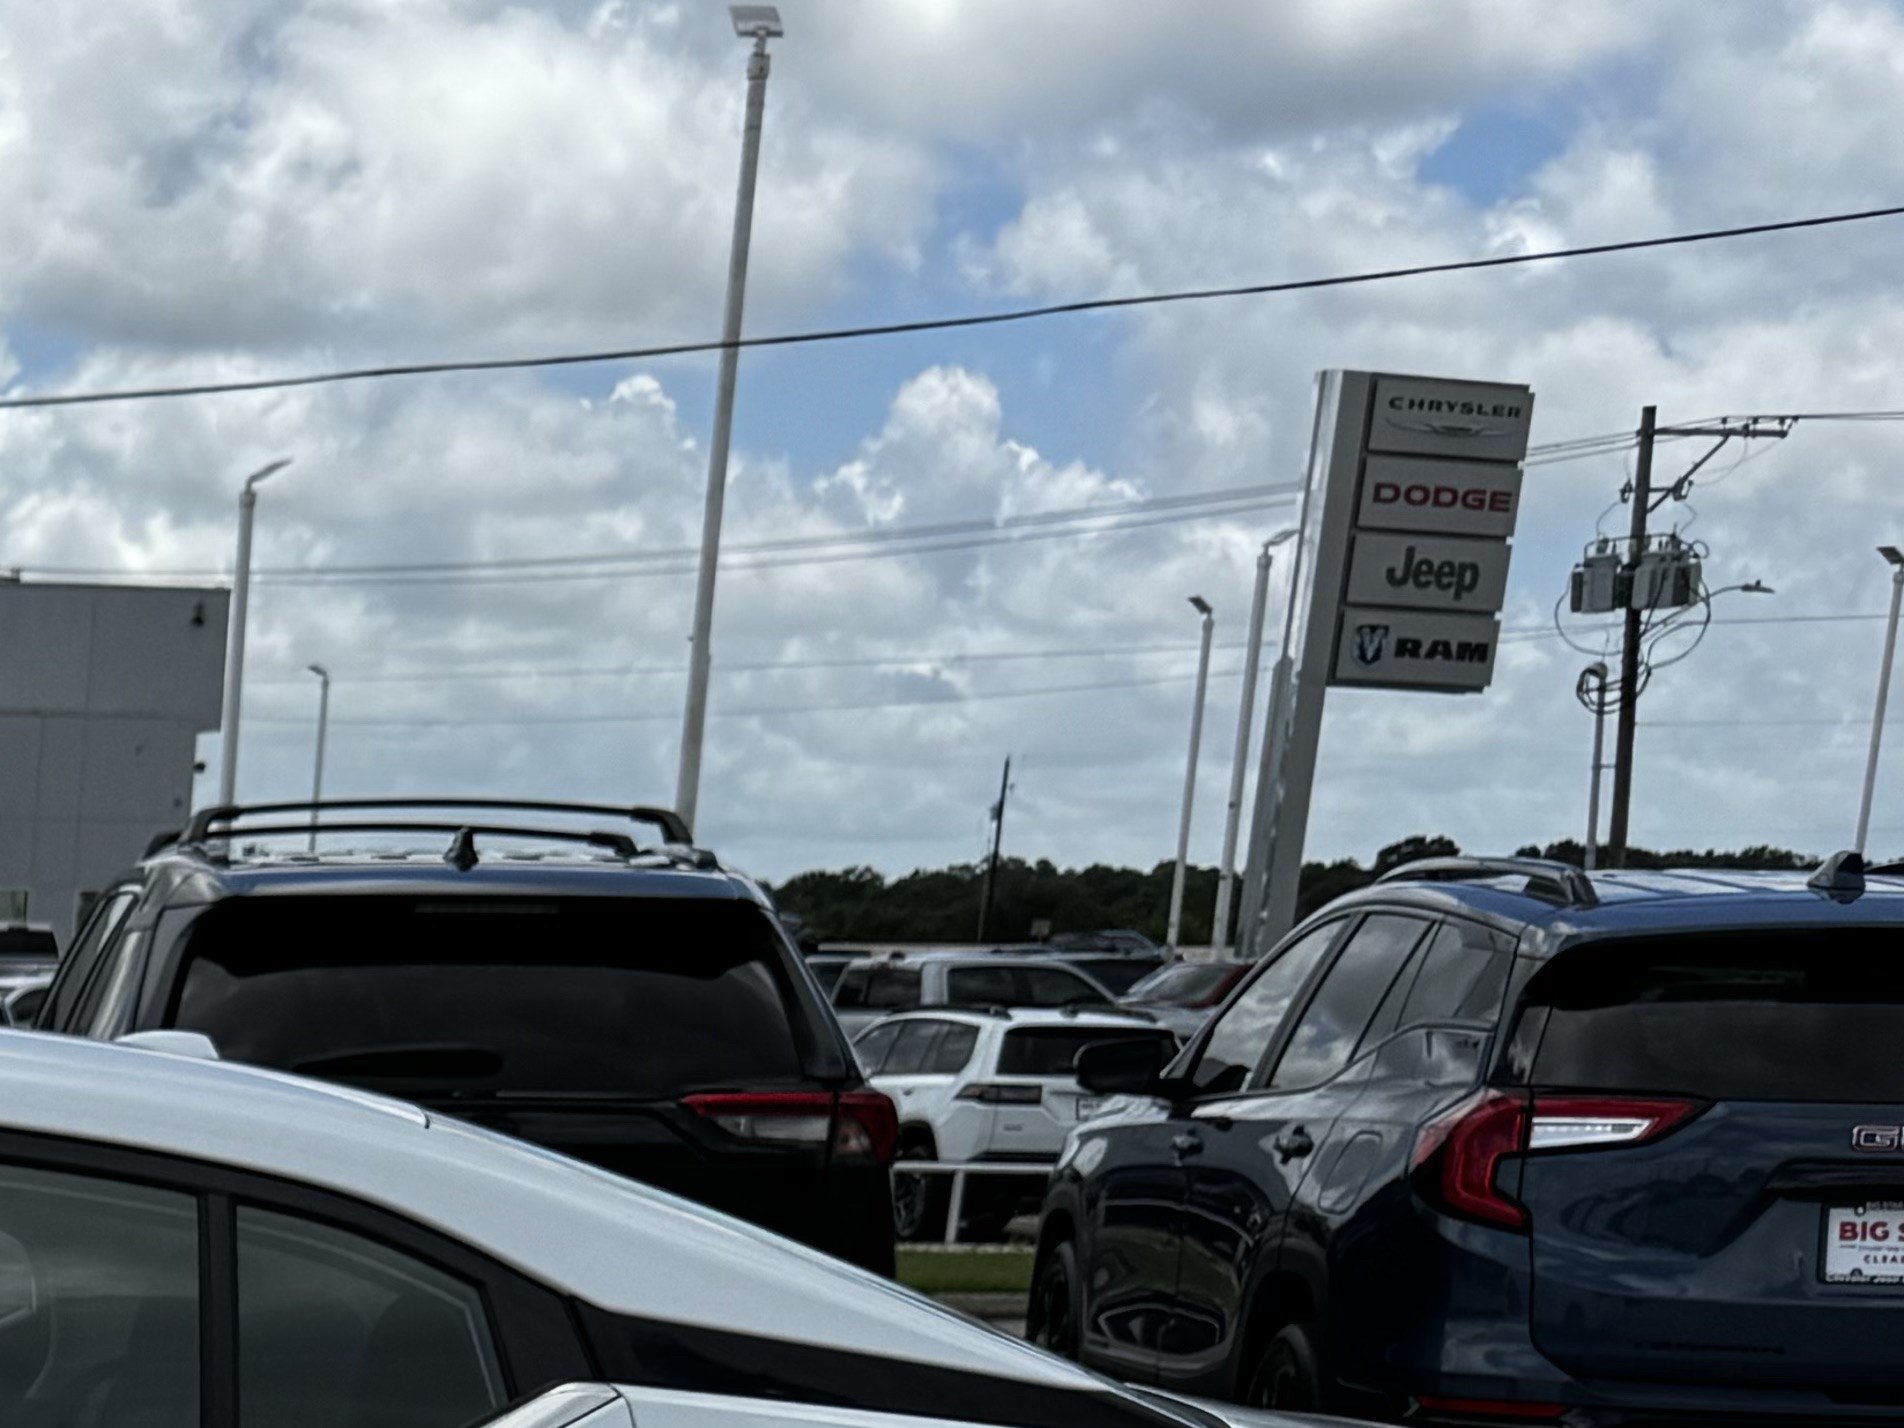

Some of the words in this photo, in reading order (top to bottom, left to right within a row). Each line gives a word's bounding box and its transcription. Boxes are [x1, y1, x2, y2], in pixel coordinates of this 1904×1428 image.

[1388, 396, 1522, 419] CHRYSLER
[1372, 481, 1513, 513] DODGE
[1385, 545, 1480, 601] Jeep
[1394, 637, 1490, 664] RAM
[1839, 1221, 1890, 1242] BIG
